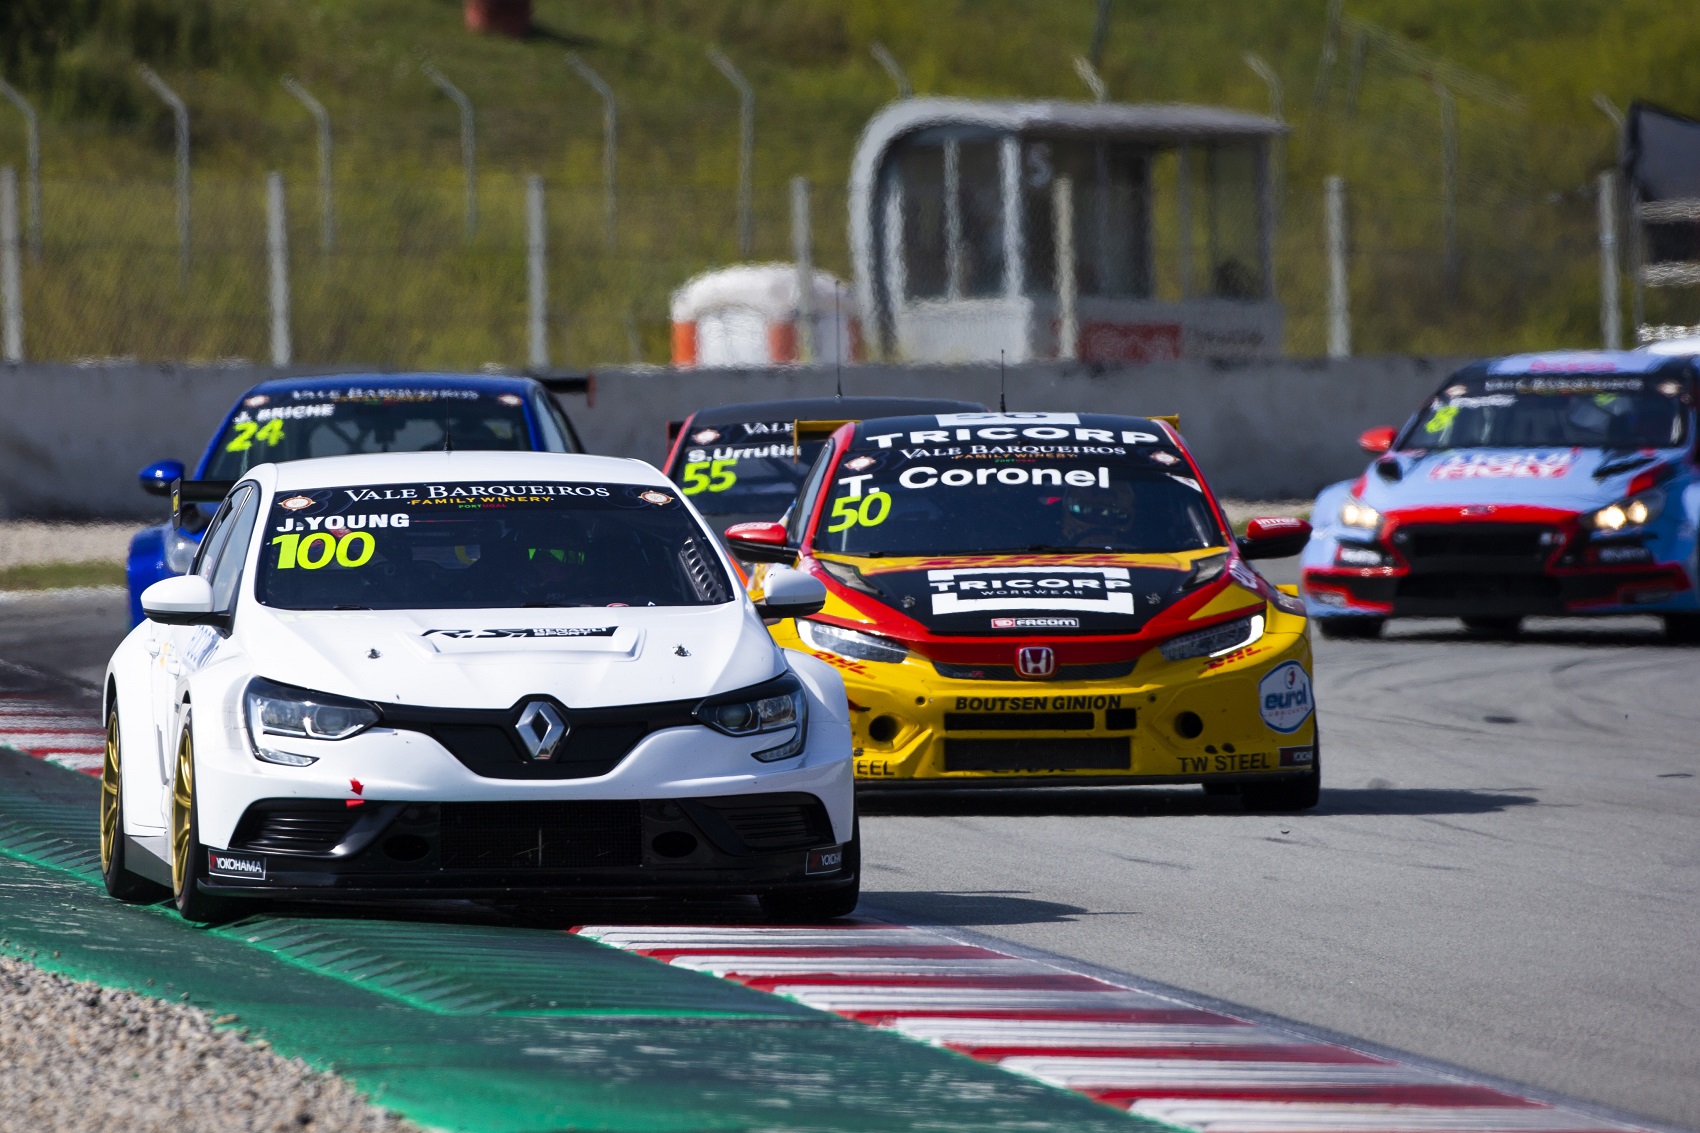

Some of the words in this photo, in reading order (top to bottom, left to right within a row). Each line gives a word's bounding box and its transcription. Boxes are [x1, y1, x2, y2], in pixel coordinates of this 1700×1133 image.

[225, 418, 286, 452] 24
[865, 426, 1160, 449] TRICORP
[900, 446, 962, 460] VALE
[970, 444, 1127, 456] BARQUEIROS
[682, 458, 737, 496] 55
[838, 473, 880, 498] T.
[899, 466, 1110, 489] Coronel
[343, 488, 418, 502] VALE
[426, 484, 611, 499] BARQUEIROS
[411, 497, 474, 506] FAMILY
[276, 513, 410, 532] J.YOUNG
[828, 491, 892, 533] 50
[271, 531, 376, 570] 100
[929, 578, 1132, 592] TRICORP
[812, 651, 868, 675] DHL
[1203, 647, 1262, 670] DHL
[955, 696, 1049, 711] BOUTSEN
[1051, 695, 1122, 710] GINION
[856, 759, 895, 776] EEL
[1177, 756, 1209, 773] TW
[1214, 751, 1271, 772] STEEL
[216, 857, 263, 873] YOKOHAMA
